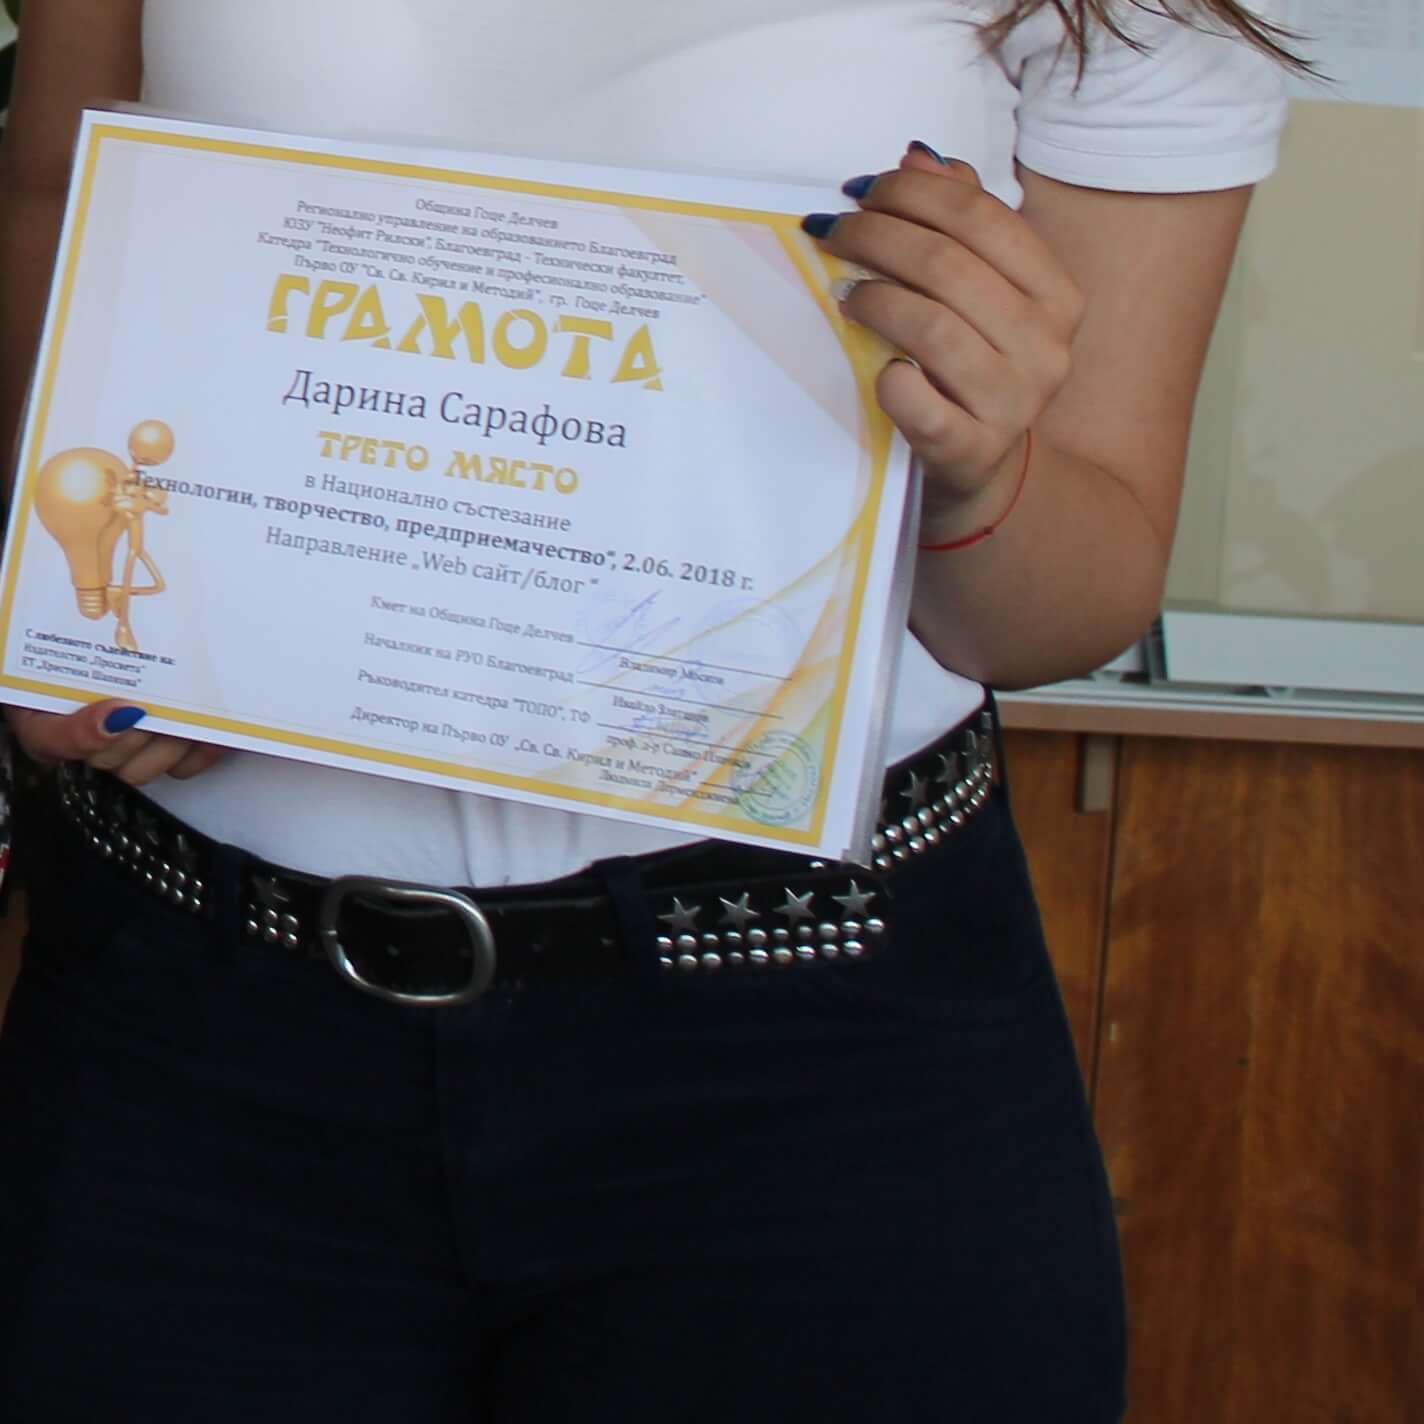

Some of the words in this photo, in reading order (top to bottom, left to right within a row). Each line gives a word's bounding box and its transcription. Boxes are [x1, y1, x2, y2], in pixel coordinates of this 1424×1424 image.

[269, 277, 662, 390] ГРАМОТА
[282, 369, 427, 419] Дарина
[440, 392, 626, 448] Сарафова
[318, 431, 430, 472] ТРЕТО
[443, 451, 579, 495] МЯСТО
[321, 473, 449, 511] Национално
[452, 500, 572, 532] състезание
[263, 495, 390, 532] творчество,
[622, 553, 674, 578] 2.06.
[679, 562, 736, 588] 2018
[741, 576, 753, 591] г.
[266, 526, 408, 566] Направление
[471, 563, 585, 595] сайт/блог
